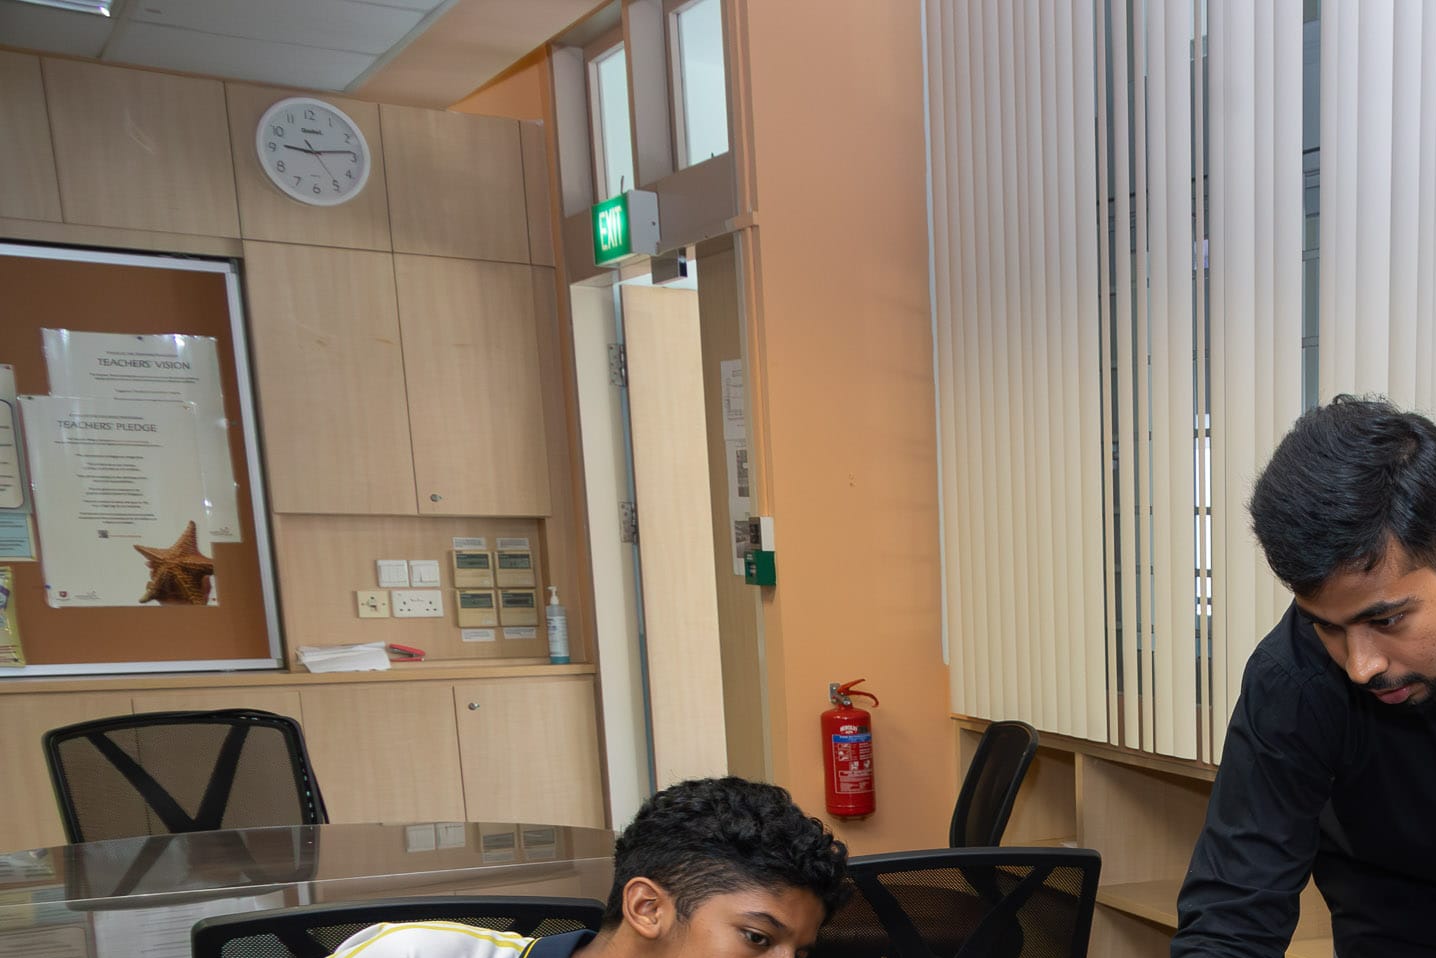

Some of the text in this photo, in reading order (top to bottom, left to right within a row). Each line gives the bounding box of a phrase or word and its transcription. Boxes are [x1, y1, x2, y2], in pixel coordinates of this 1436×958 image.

[598, 205, 623, 251] EXIT
[155, 360, 191, 370] VISION
[116, 422, 157, 432] PLEDGE
